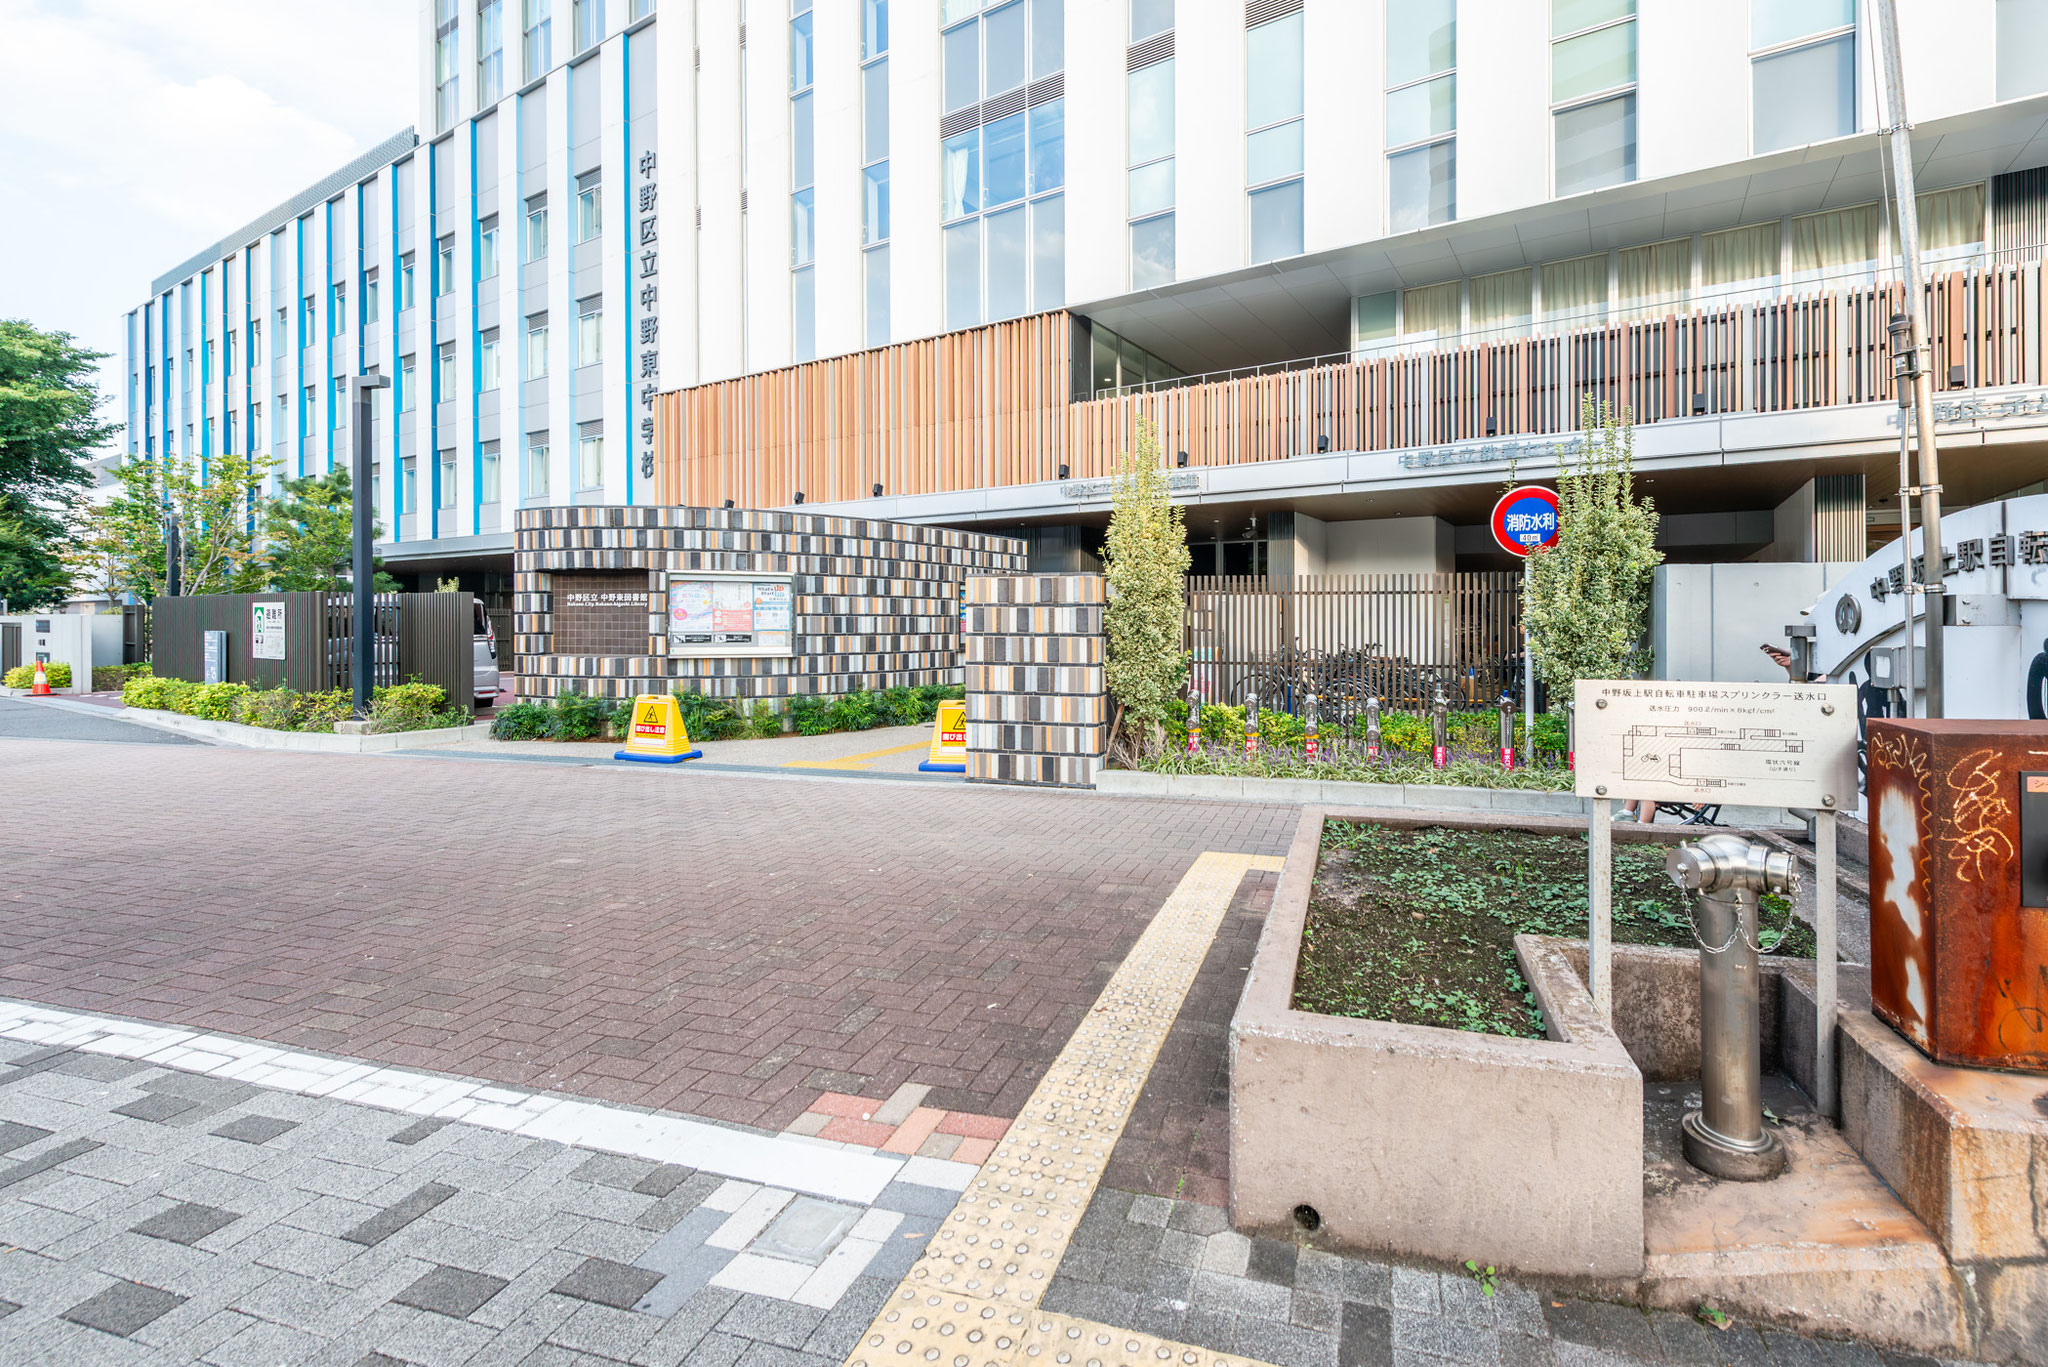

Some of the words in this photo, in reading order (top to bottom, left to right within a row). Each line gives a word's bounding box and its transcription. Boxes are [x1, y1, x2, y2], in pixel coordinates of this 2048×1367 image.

[1507, 513, 1555, 531] 消防水利
[567, 593, 598, 602] 中野区立
[601, 593, 648, 602] 中野東図書館
[1602, 688, 1827, 702] 中野坂上駅自転車駐車場スプリンクラー送水口
[1649, 705, 1680, 713] 送水圧力
